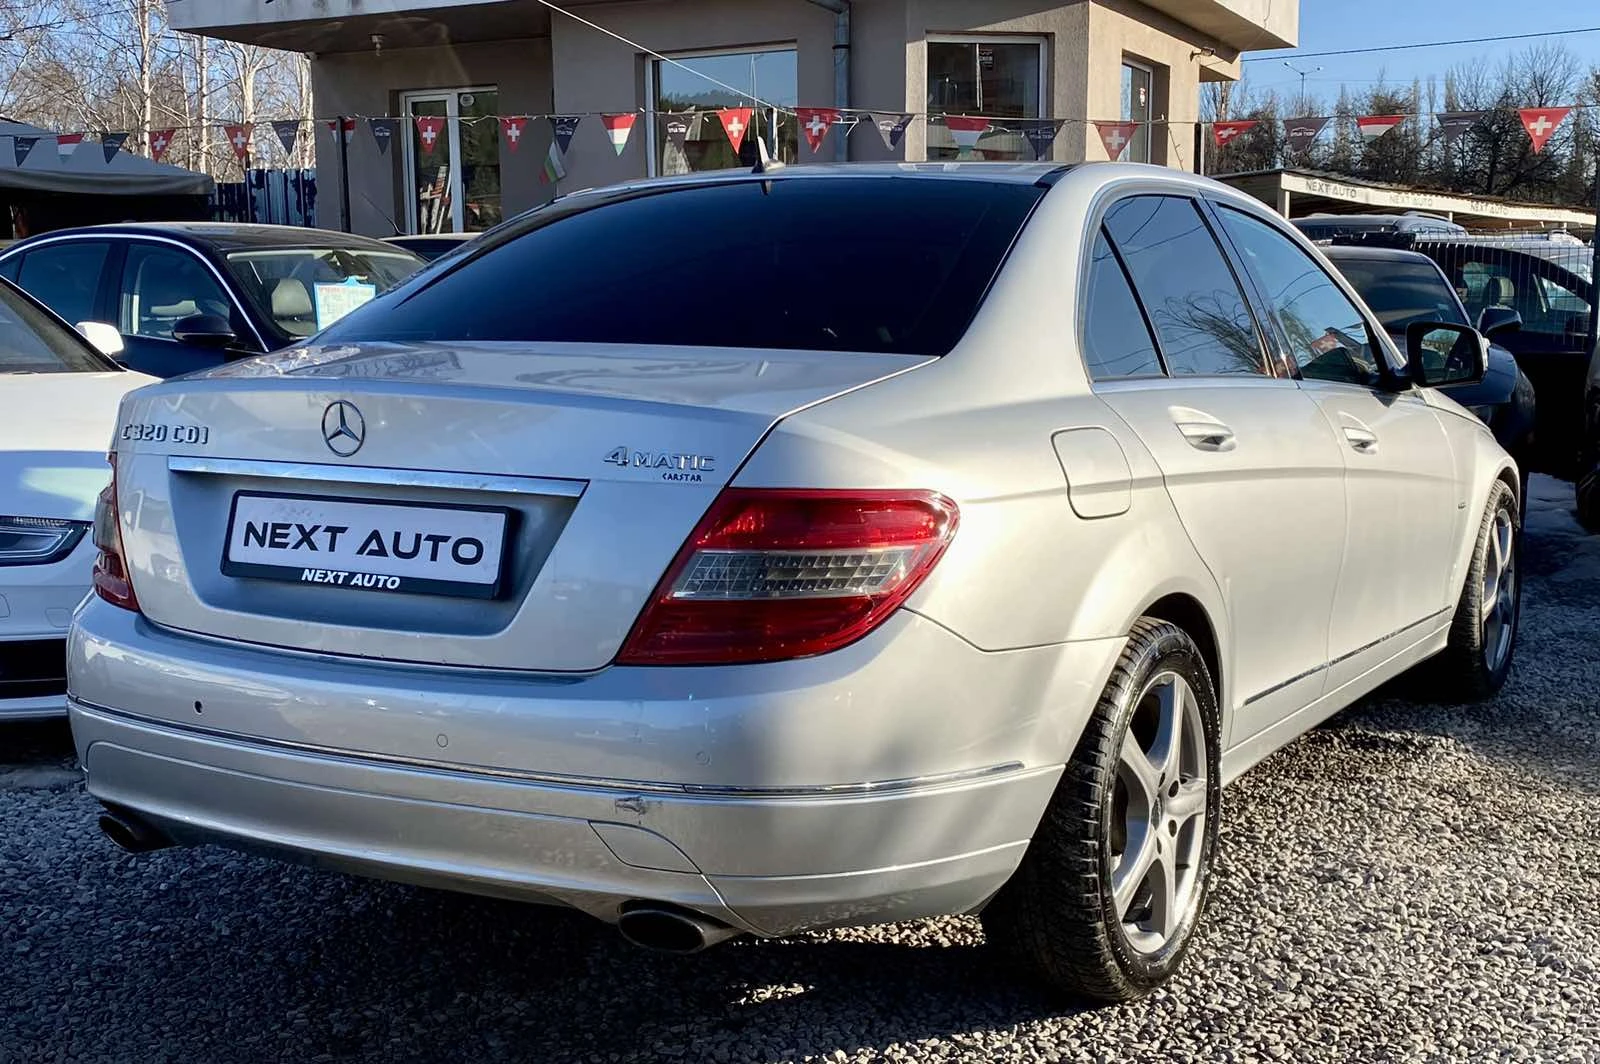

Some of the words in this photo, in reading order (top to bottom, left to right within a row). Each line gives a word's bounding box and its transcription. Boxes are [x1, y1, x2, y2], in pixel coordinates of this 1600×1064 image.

[1305, 181, 1329, 193] NEXT
[1331, 184, 1357, 198] AUTO
[121, 424, 168, 441] C320
[172, 426, 209, 444] CDI
[662, 473, 702, 482] CARSTAR
[243, 521, 348, 552] NEXT
[356, 529, 484, 565] AUTO
[301, 568, 349, 585] NEXT
[350, 573, 400, 590] AUTO
